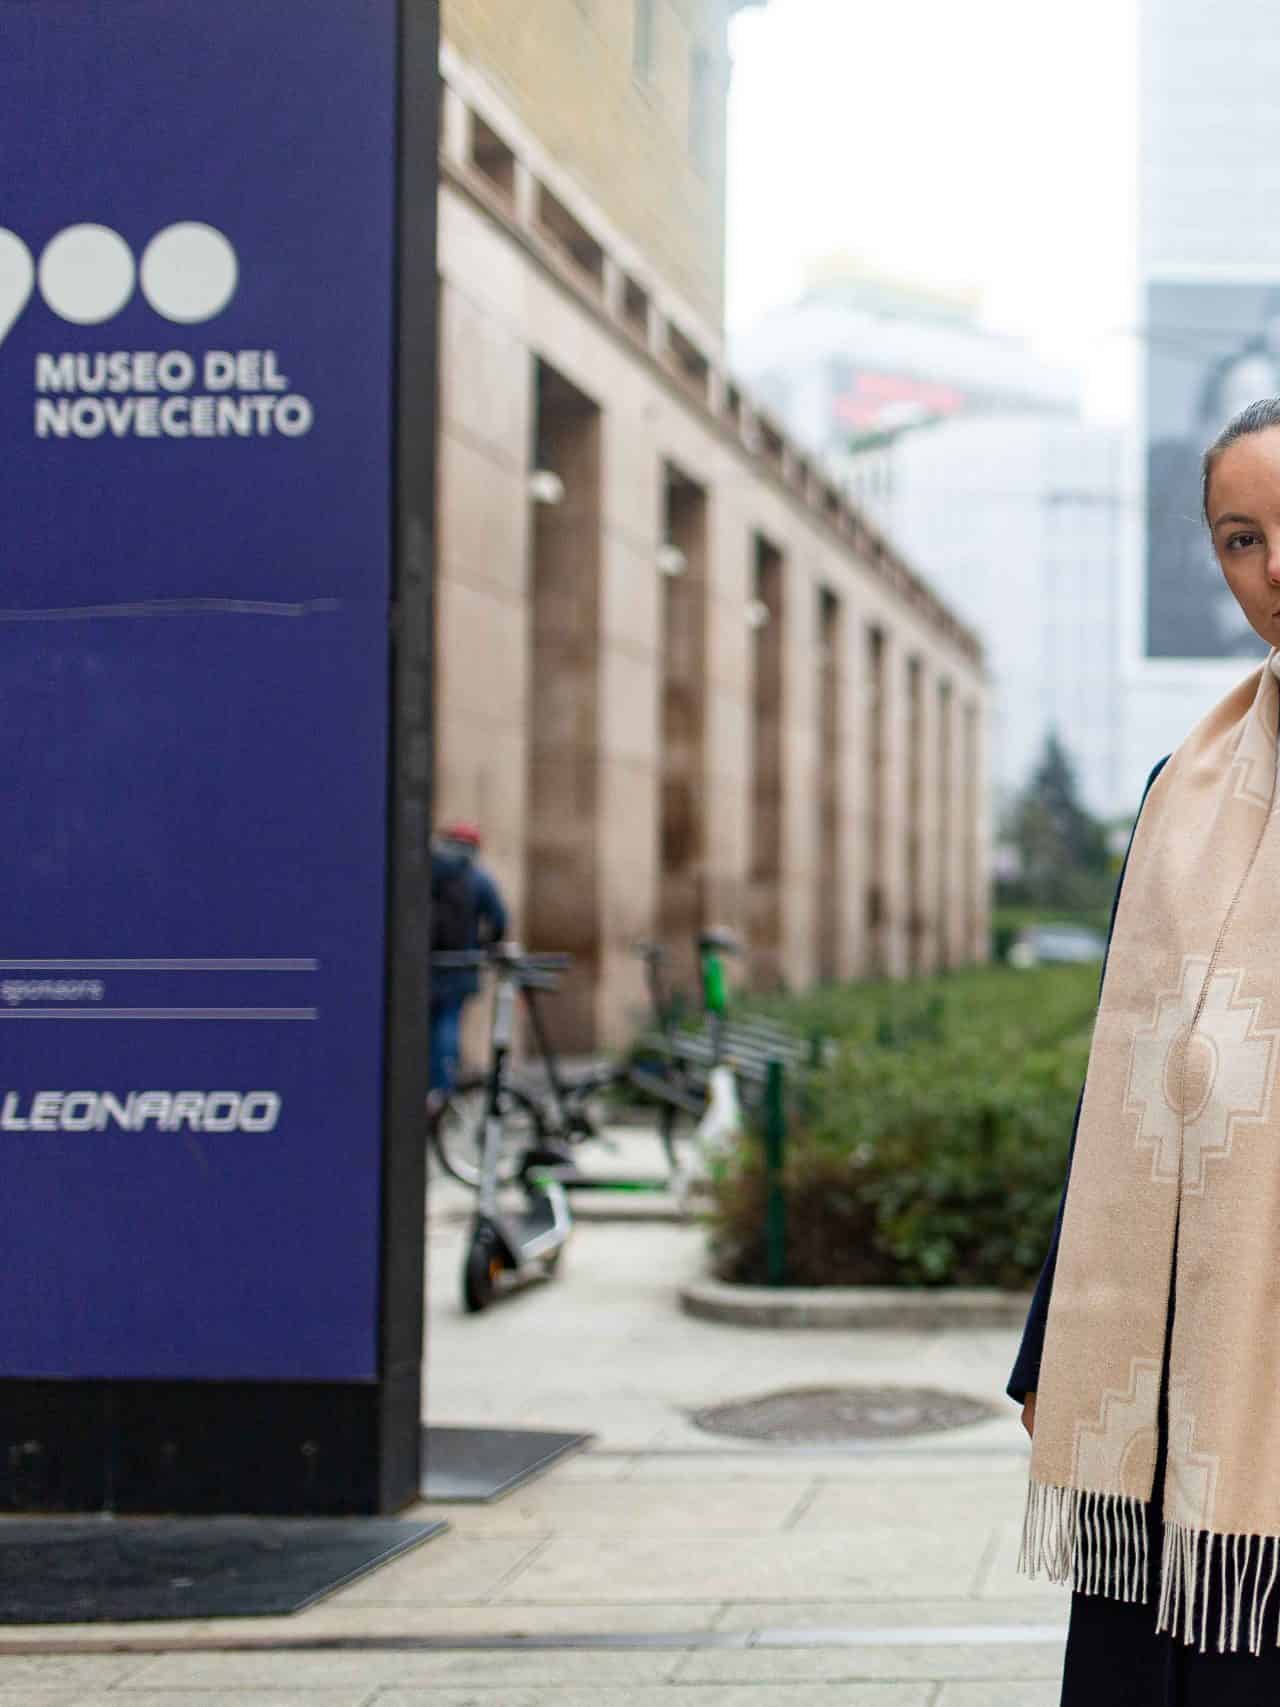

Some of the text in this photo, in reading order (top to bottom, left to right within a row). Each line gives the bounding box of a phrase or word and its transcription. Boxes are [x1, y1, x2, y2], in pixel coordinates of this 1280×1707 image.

[36, 350, 287, 392] MUSEO DEL
[36, 395, 313, 439] NOVECENTO
[1, 1090, 282, 1132] LEONARDO
